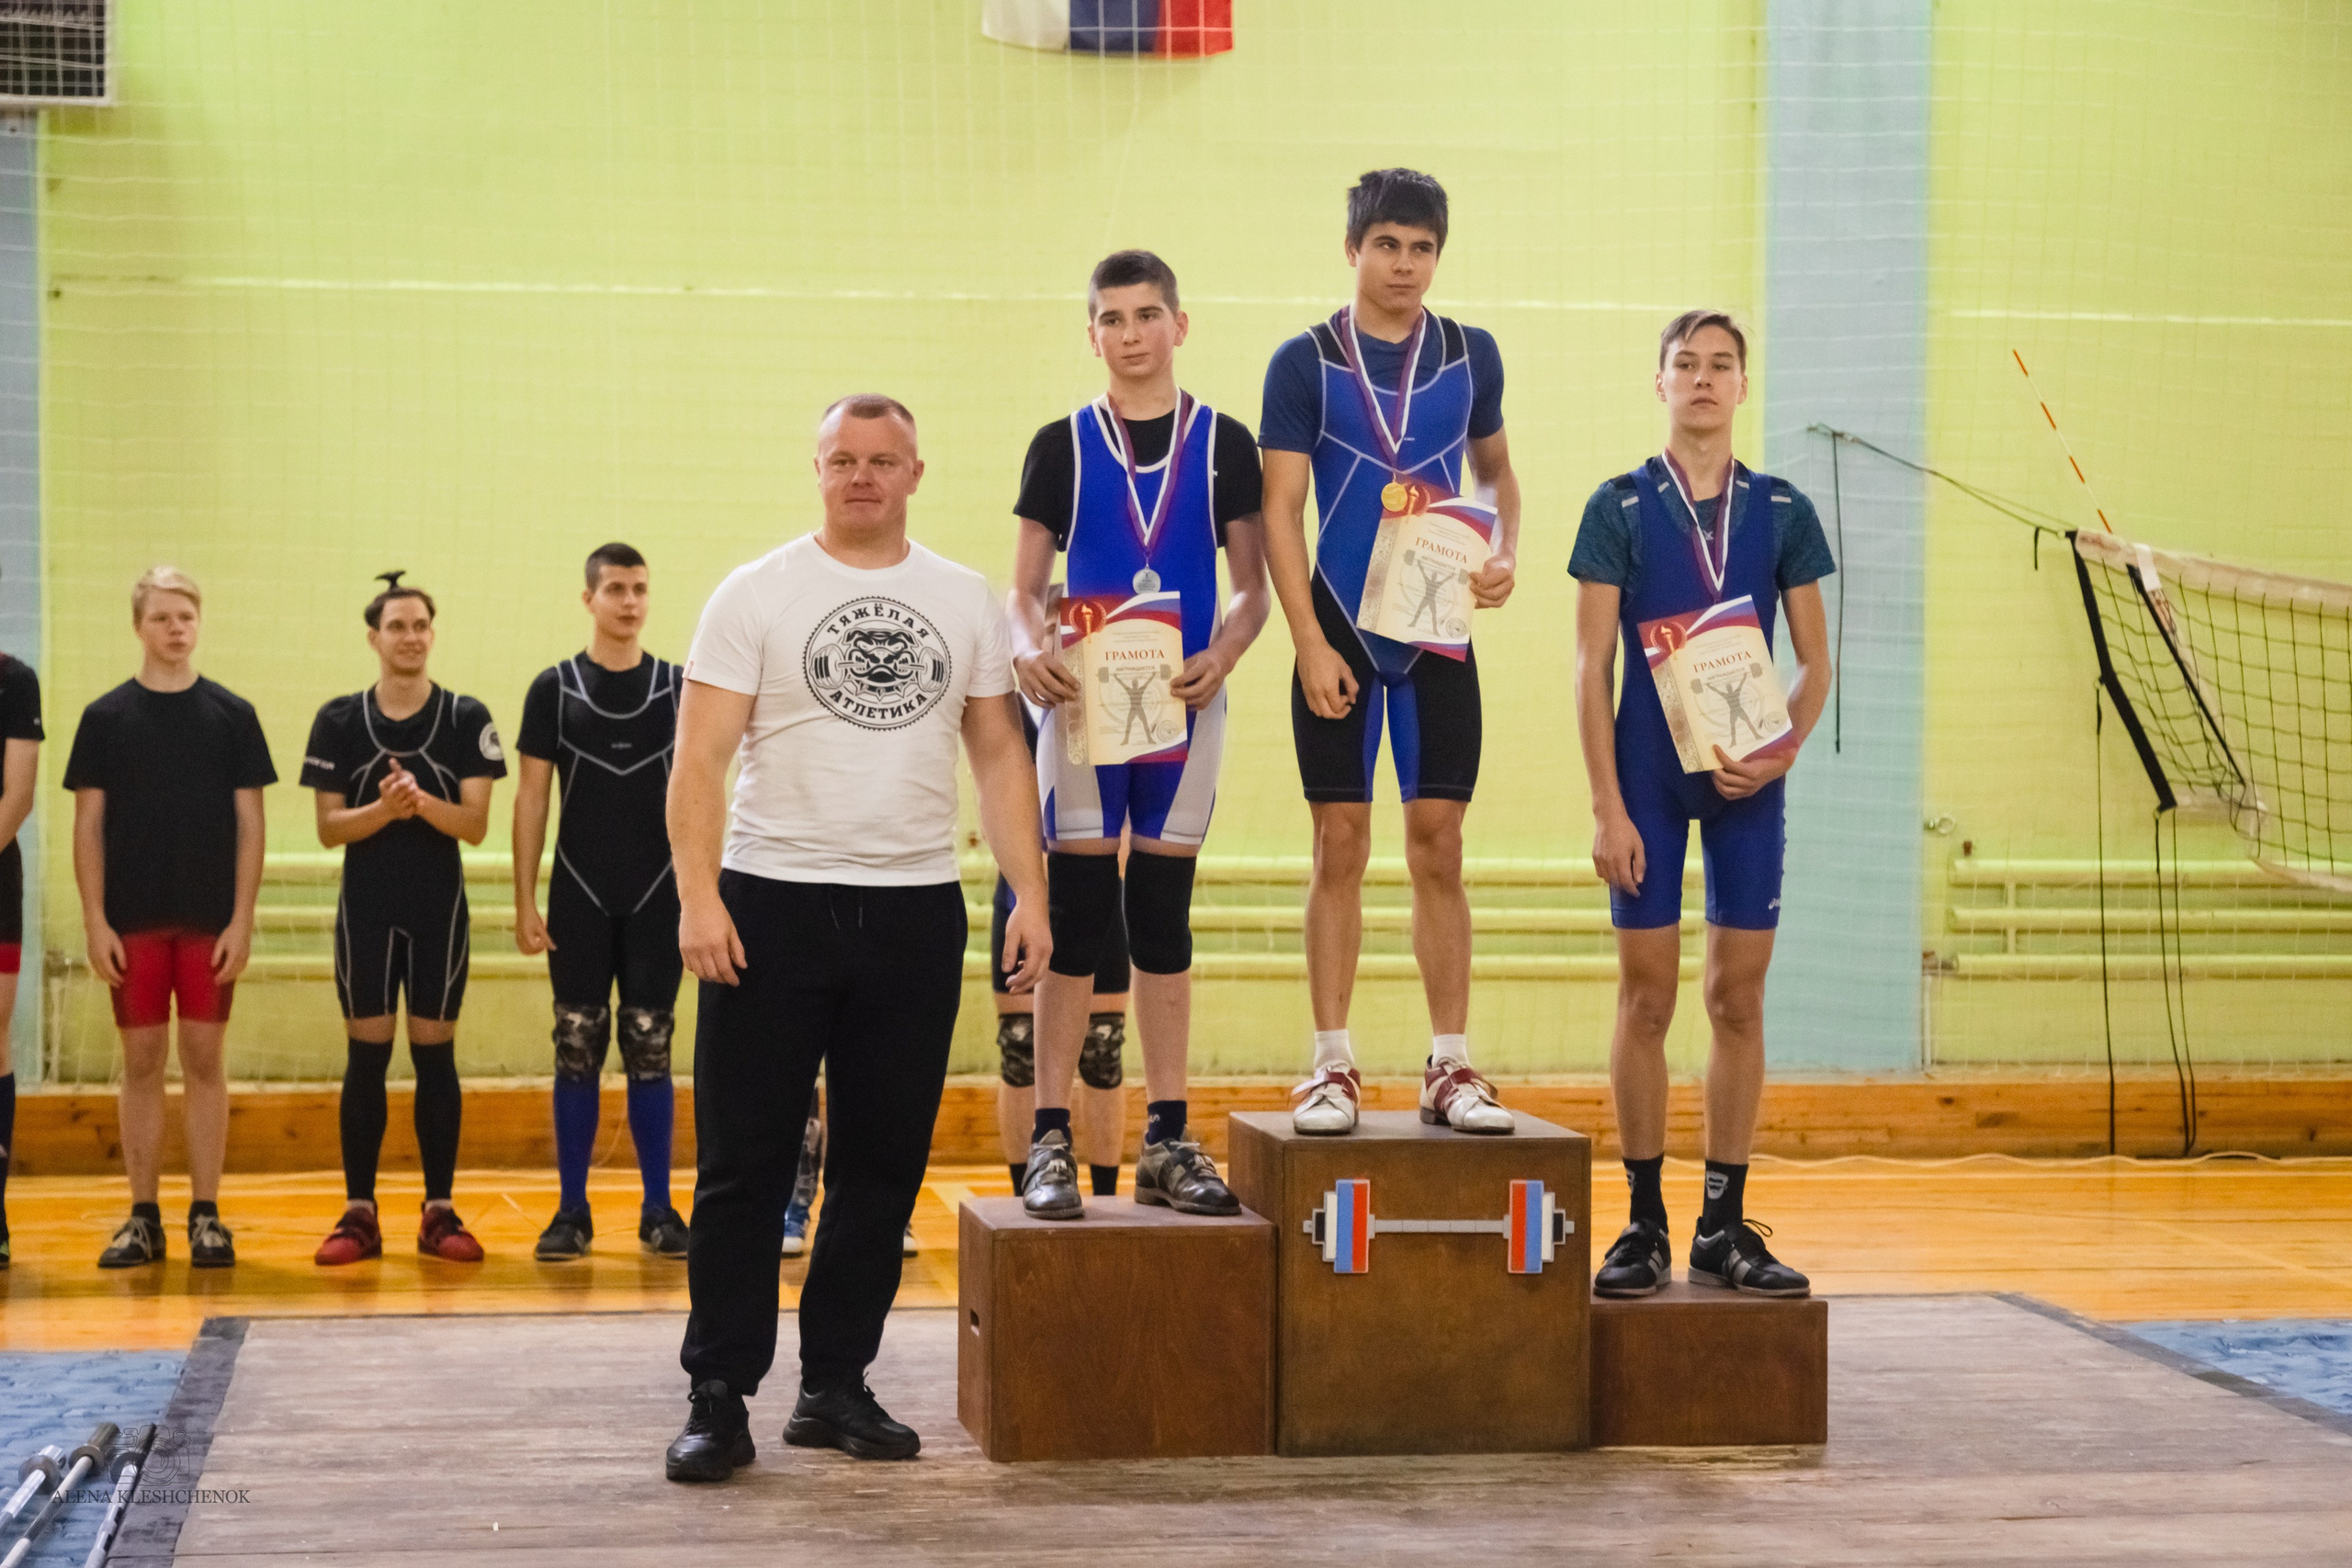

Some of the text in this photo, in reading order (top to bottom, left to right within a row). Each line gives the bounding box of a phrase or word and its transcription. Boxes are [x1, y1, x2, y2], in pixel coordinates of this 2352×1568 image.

[1415, 536, 1468, 564] ГРАМОТА
[827, 603, 930, 638] ТЯЖЁЛАЯ
[1104, 649, 1165, 660] ГРАМОТА
[1692, 650, 1752, 673] ГРАМОТА
[829, 690, 928, 719] АТЛЕТИКА
